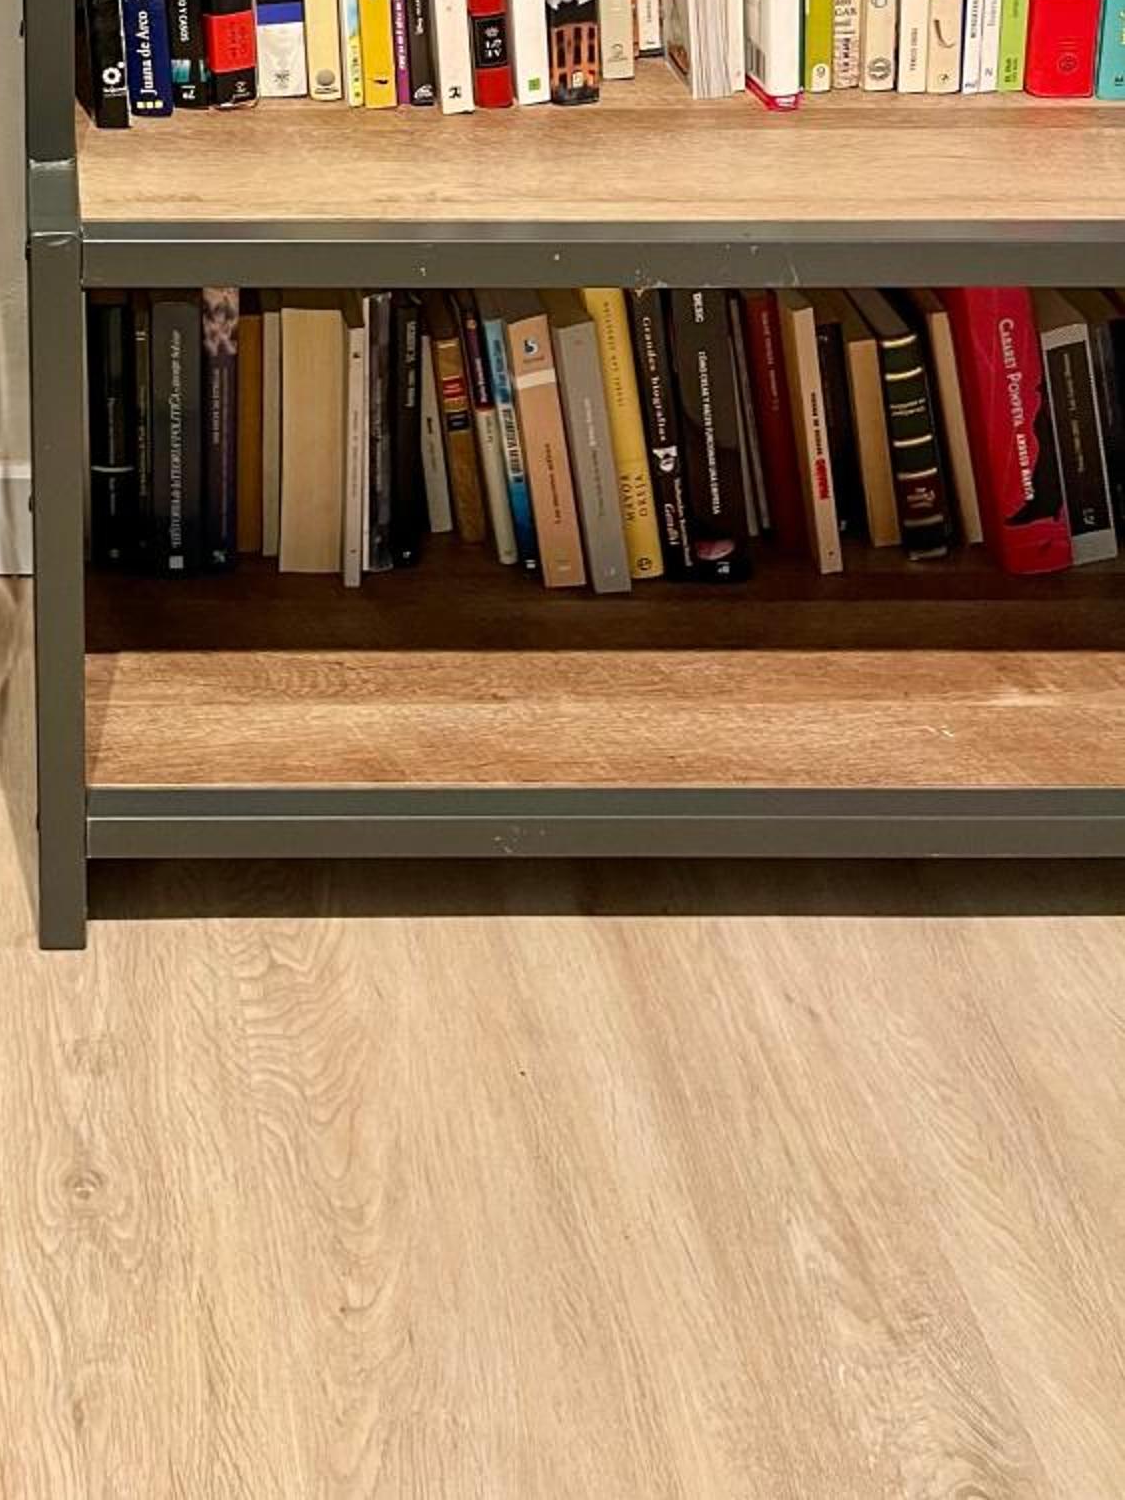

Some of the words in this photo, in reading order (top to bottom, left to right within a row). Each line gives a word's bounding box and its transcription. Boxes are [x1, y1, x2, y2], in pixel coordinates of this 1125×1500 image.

[135, 11, 150, 40] Arco
[180, 15, 191, 42] CASOS
[136, 42, 151, 57] de
[137, 60, 157, 95] Juana
[641, 317, 656, 371] Grandes
[997, 319, 1017, 369] CABARET
[664, 503, 681, 546] Gandhi
